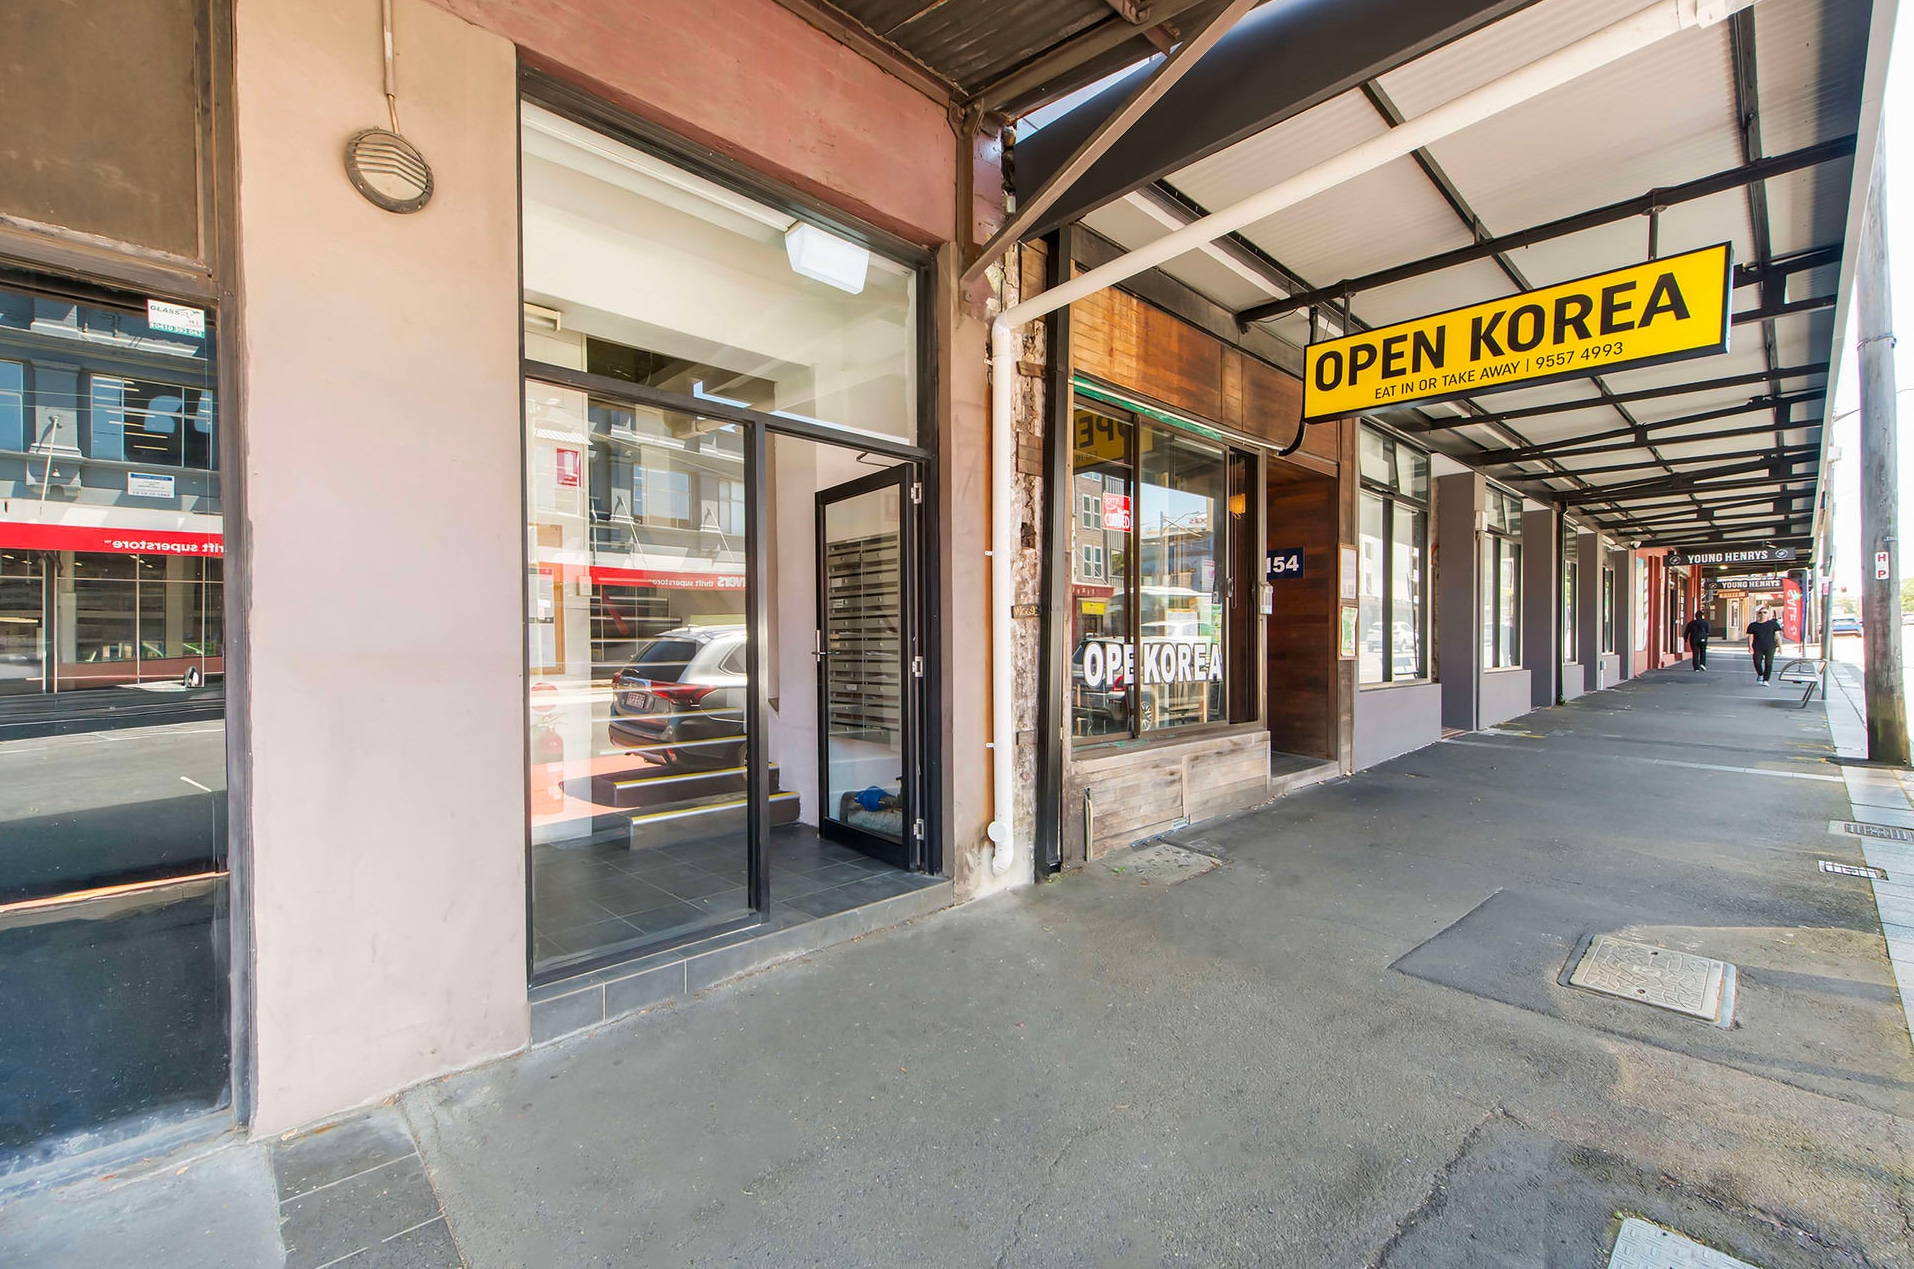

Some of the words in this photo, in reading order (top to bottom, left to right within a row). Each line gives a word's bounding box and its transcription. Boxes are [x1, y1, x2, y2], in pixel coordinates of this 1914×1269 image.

[1315, 325, 1446, 392] OPEN
[1469, 271, 1691, 362] KOREA
[1374, 384, 1396, 400] EAT
[1401, 381, 1414, 395] IN
[1418, 377, 1437, 391] OR
[1442, 370, 1475, 387] TAKE
[1479, 361, 1521, 381] AWAY
[1535, 350, 1575, 370] 9557
[1580, 341, 1623, 361] 4993
[1266, 554, 1299, 574] 154
[1687, 553, 1723, 564] YOUNG
[1725, 550, 1768, 562] HENRYS
[1721, 581, 1748, 589] YOUNG
[1749, 579, 1780, 588] HENRYS
[1142, 642, 1223, 685] KOREA
